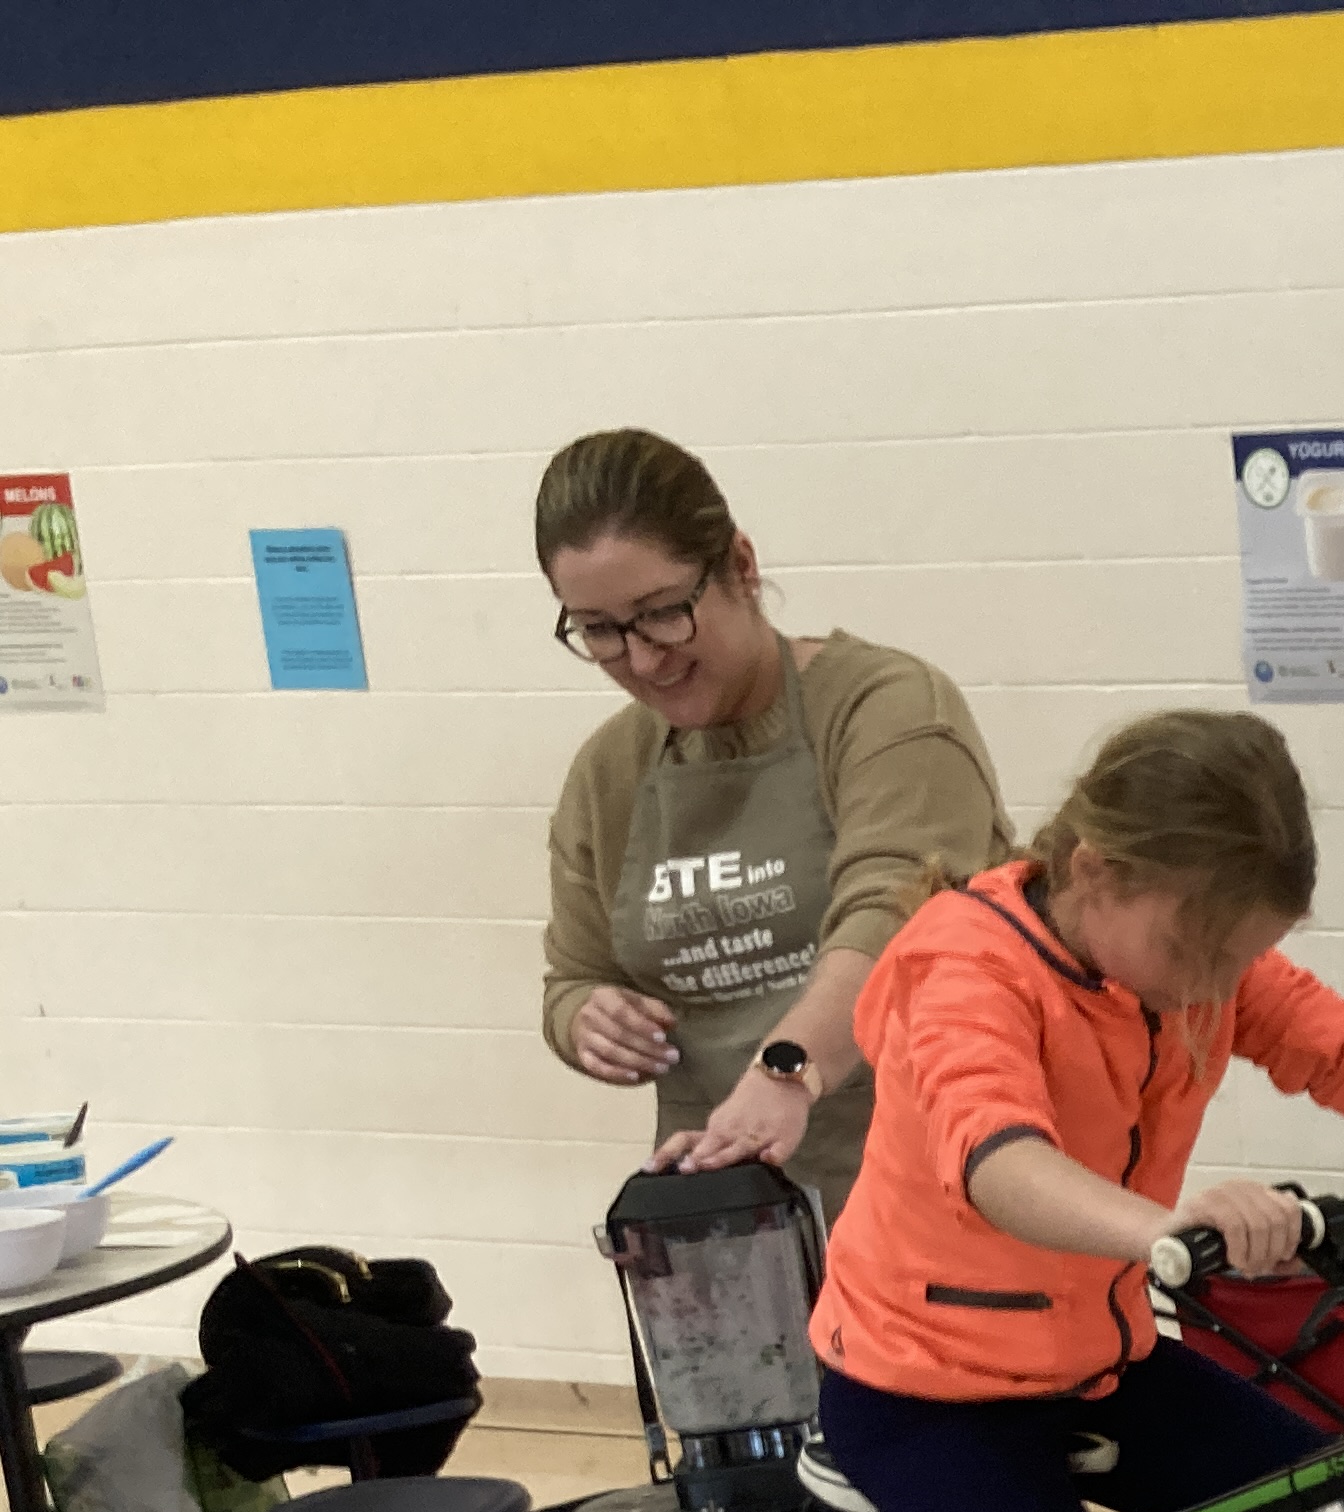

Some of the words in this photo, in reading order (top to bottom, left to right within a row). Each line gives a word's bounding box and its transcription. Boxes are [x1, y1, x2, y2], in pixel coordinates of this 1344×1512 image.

[4, 486, 56, 503] MELONS
[747, 858, 785, 885] into
[720, 928, 774, 956] taste
